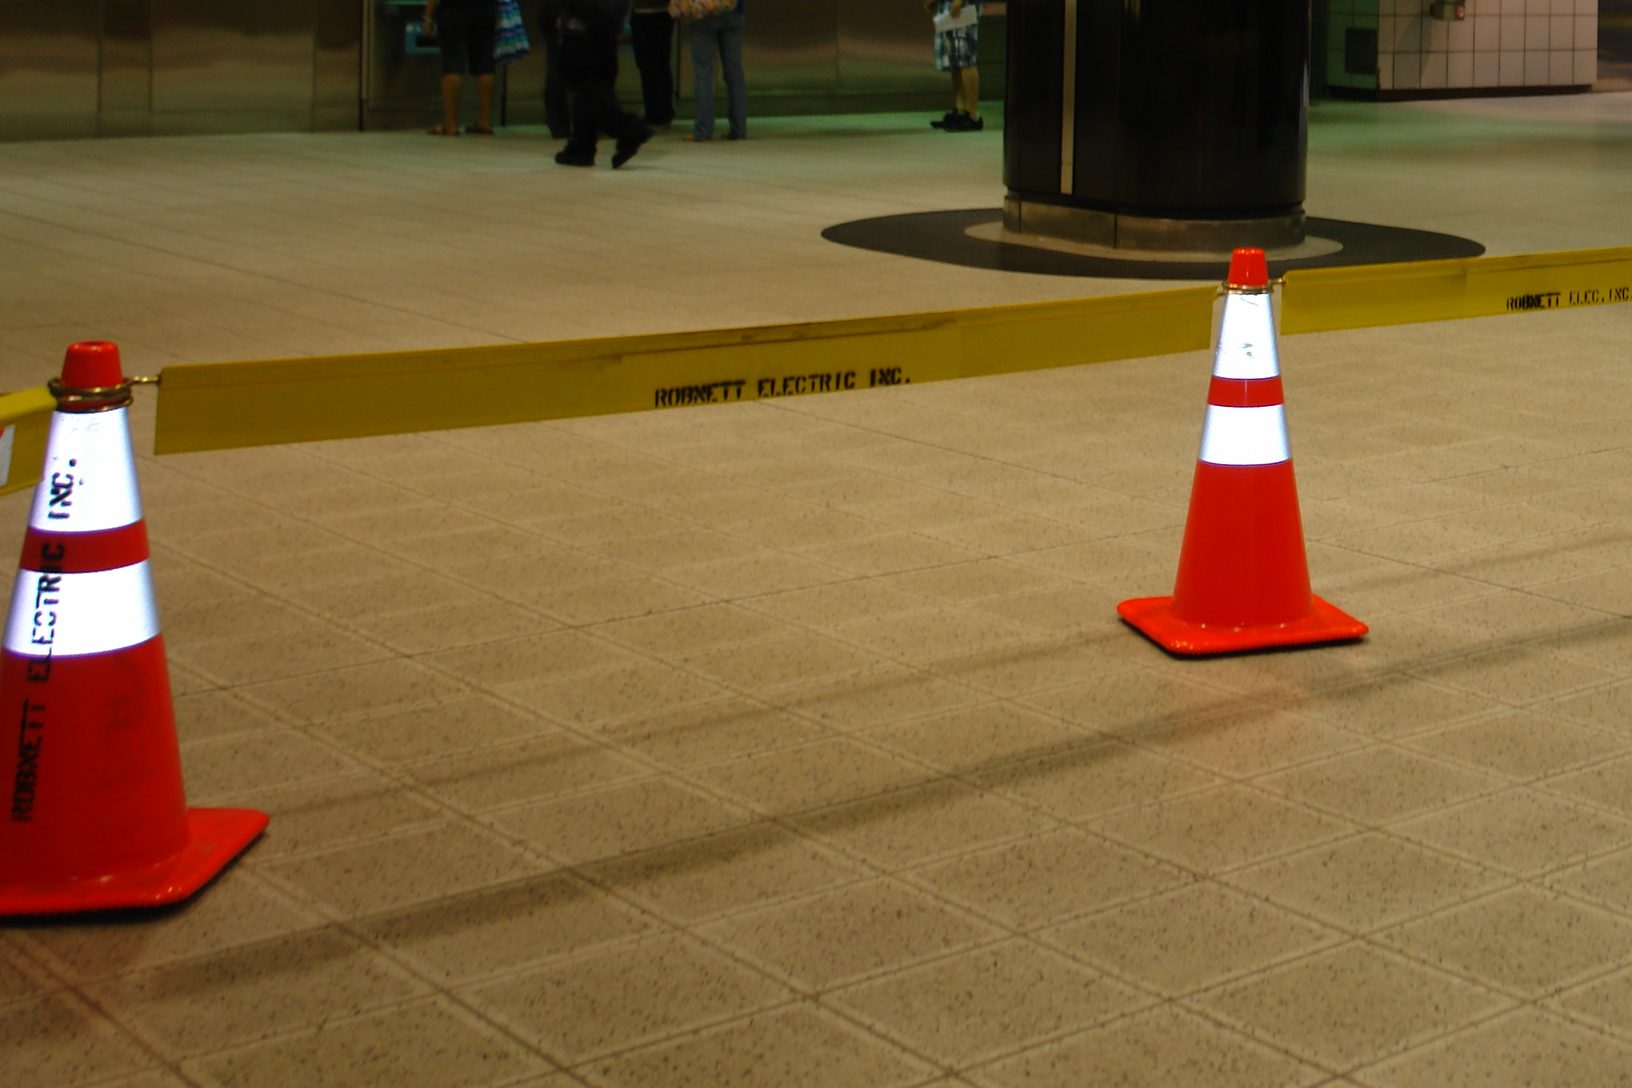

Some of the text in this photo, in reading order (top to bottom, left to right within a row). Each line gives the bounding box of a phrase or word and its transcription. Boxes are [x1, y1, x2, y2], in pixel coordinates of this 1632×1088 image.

[757, 371, 857, 399] ELECTRIC
[869, 367, 912, 388] INC.
[27, 541, 66, 684] ELECTRIC
[47, 456, 78, 521] INC.
